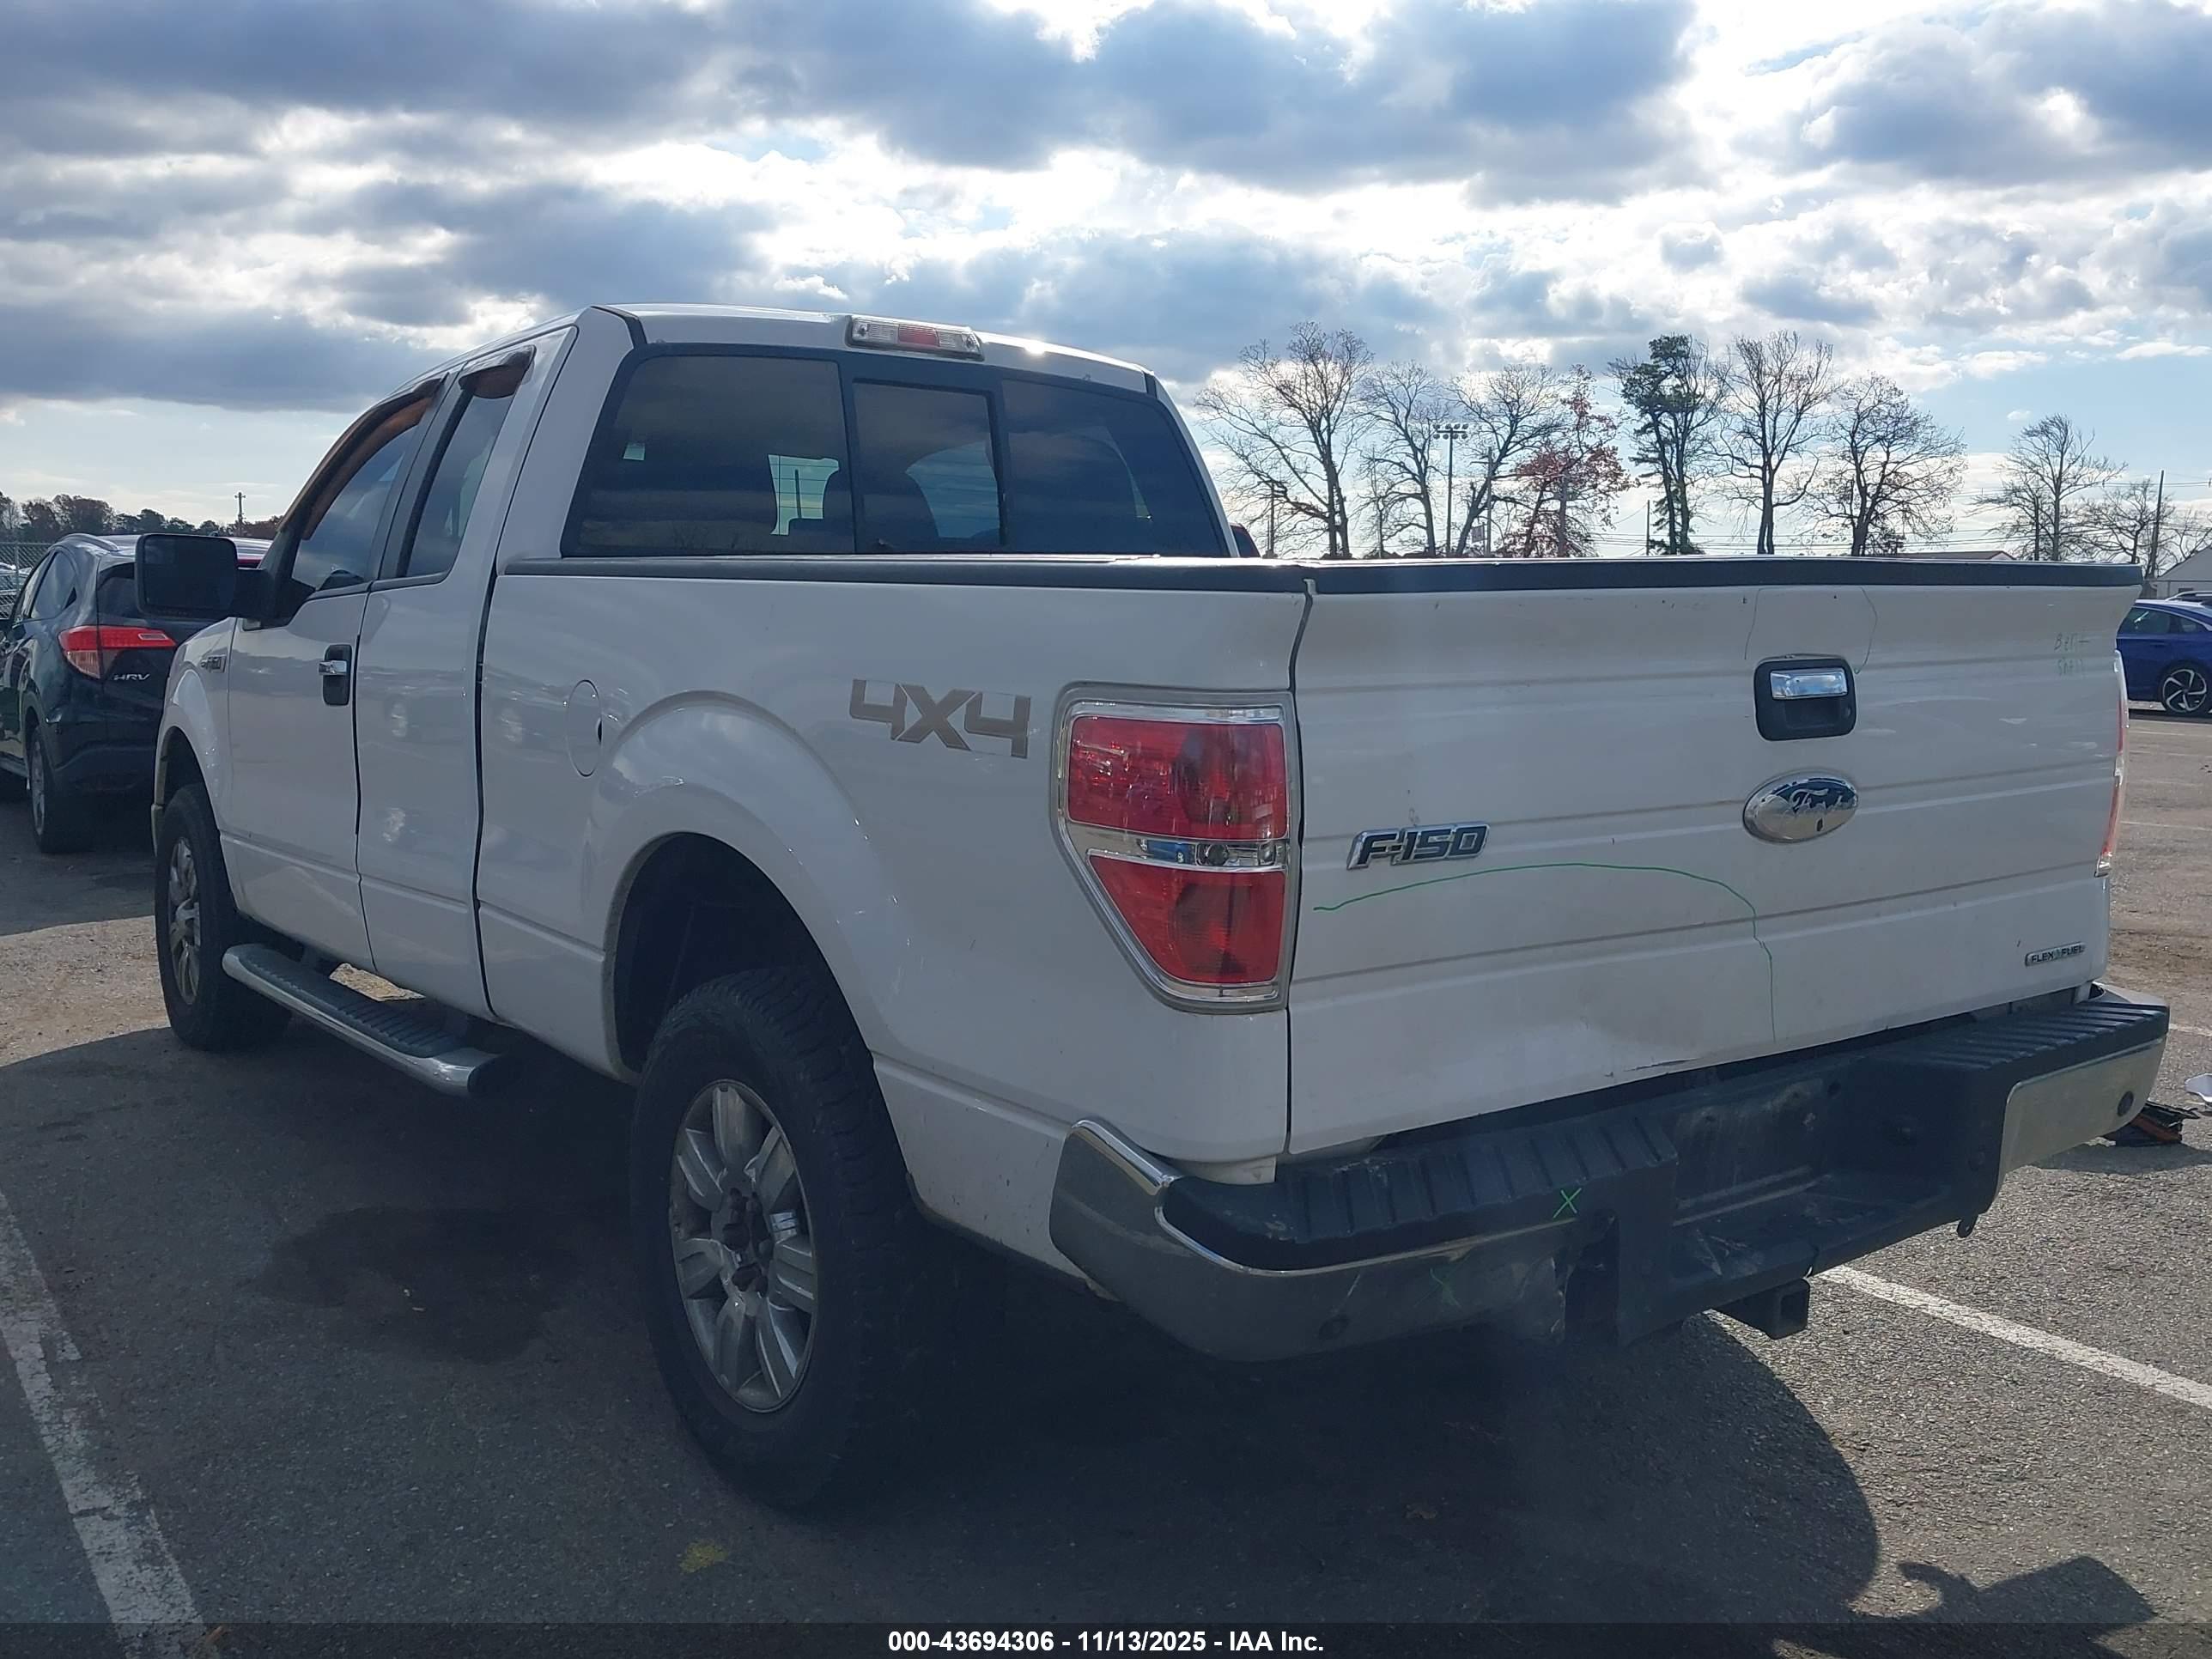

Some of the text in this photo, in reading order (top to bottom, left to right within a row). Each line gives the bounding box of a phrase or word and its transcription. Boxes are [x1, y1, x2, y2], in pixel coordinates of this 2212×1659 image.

[849, 678, 1030, 759] 4X4
[1346, 821, 1491, 871] F-150
[2032, 945, 2085, 963] FLEX FUEL
